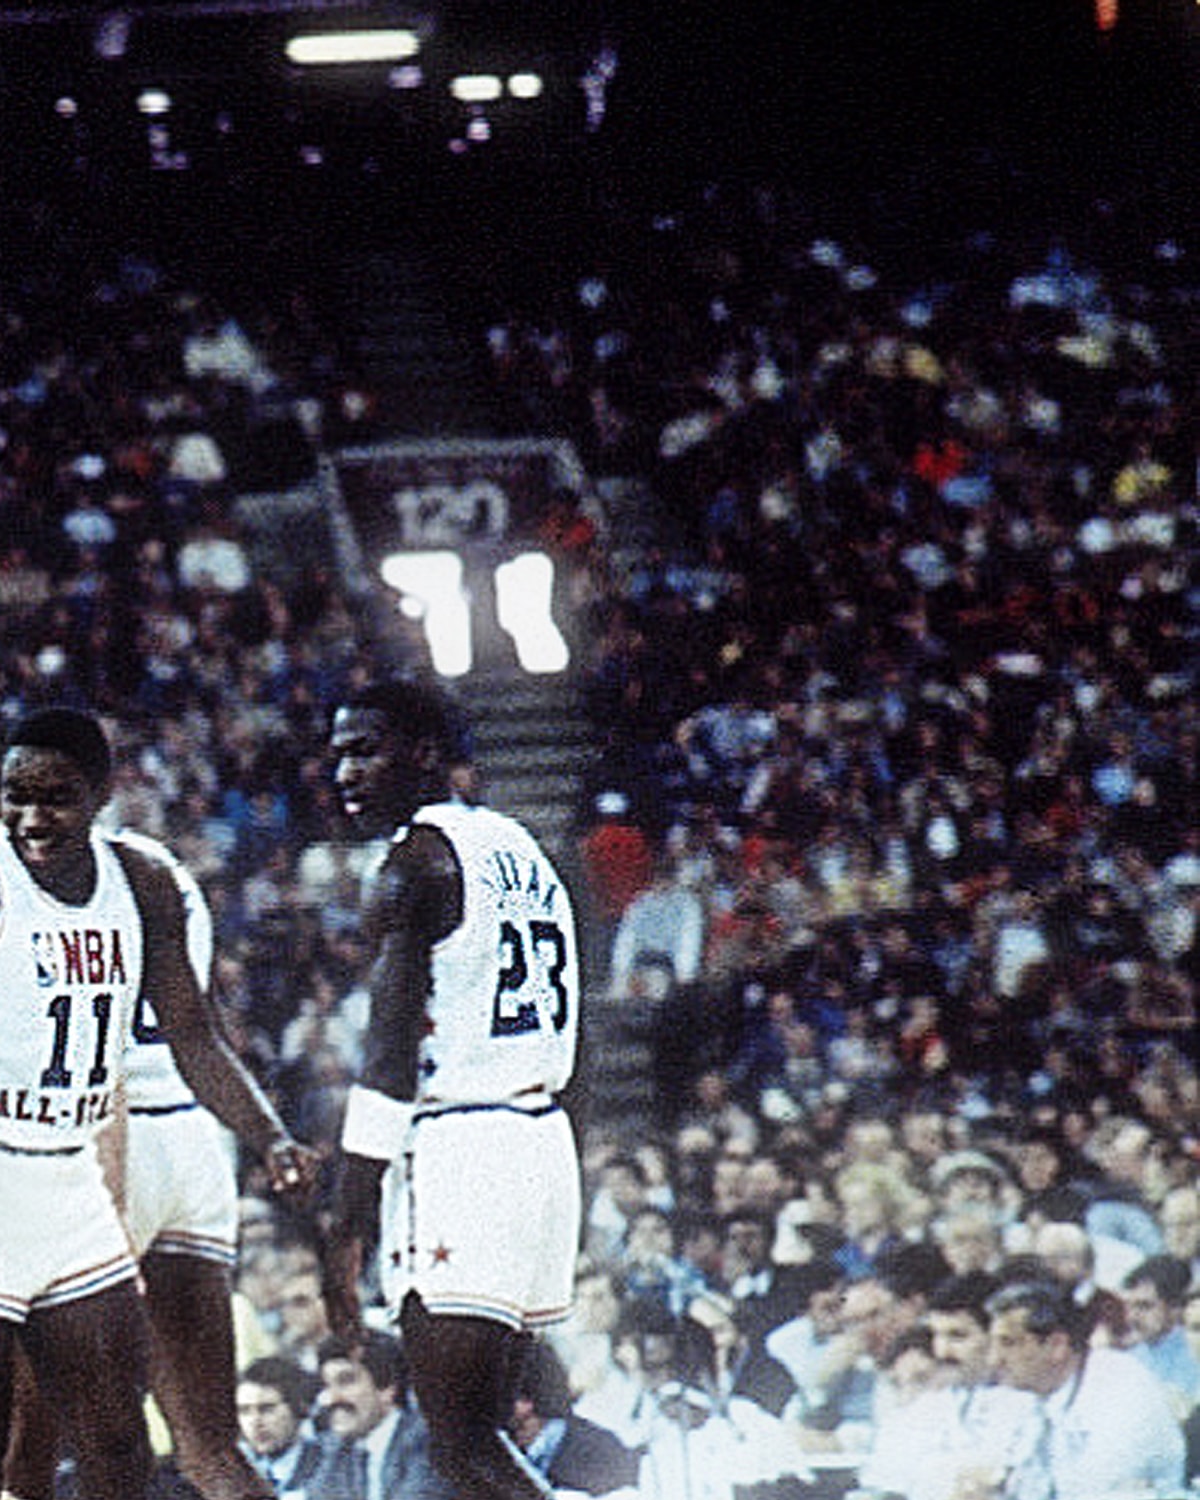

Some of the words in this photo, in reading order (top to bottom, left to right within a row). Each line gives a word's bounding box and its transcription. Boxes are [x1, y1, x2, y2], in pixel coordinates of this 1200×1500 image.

[59, 929, 126, 985] NBA
[490, 920, 568, 1037] 23
[39, 992, 115, 1089] 11
